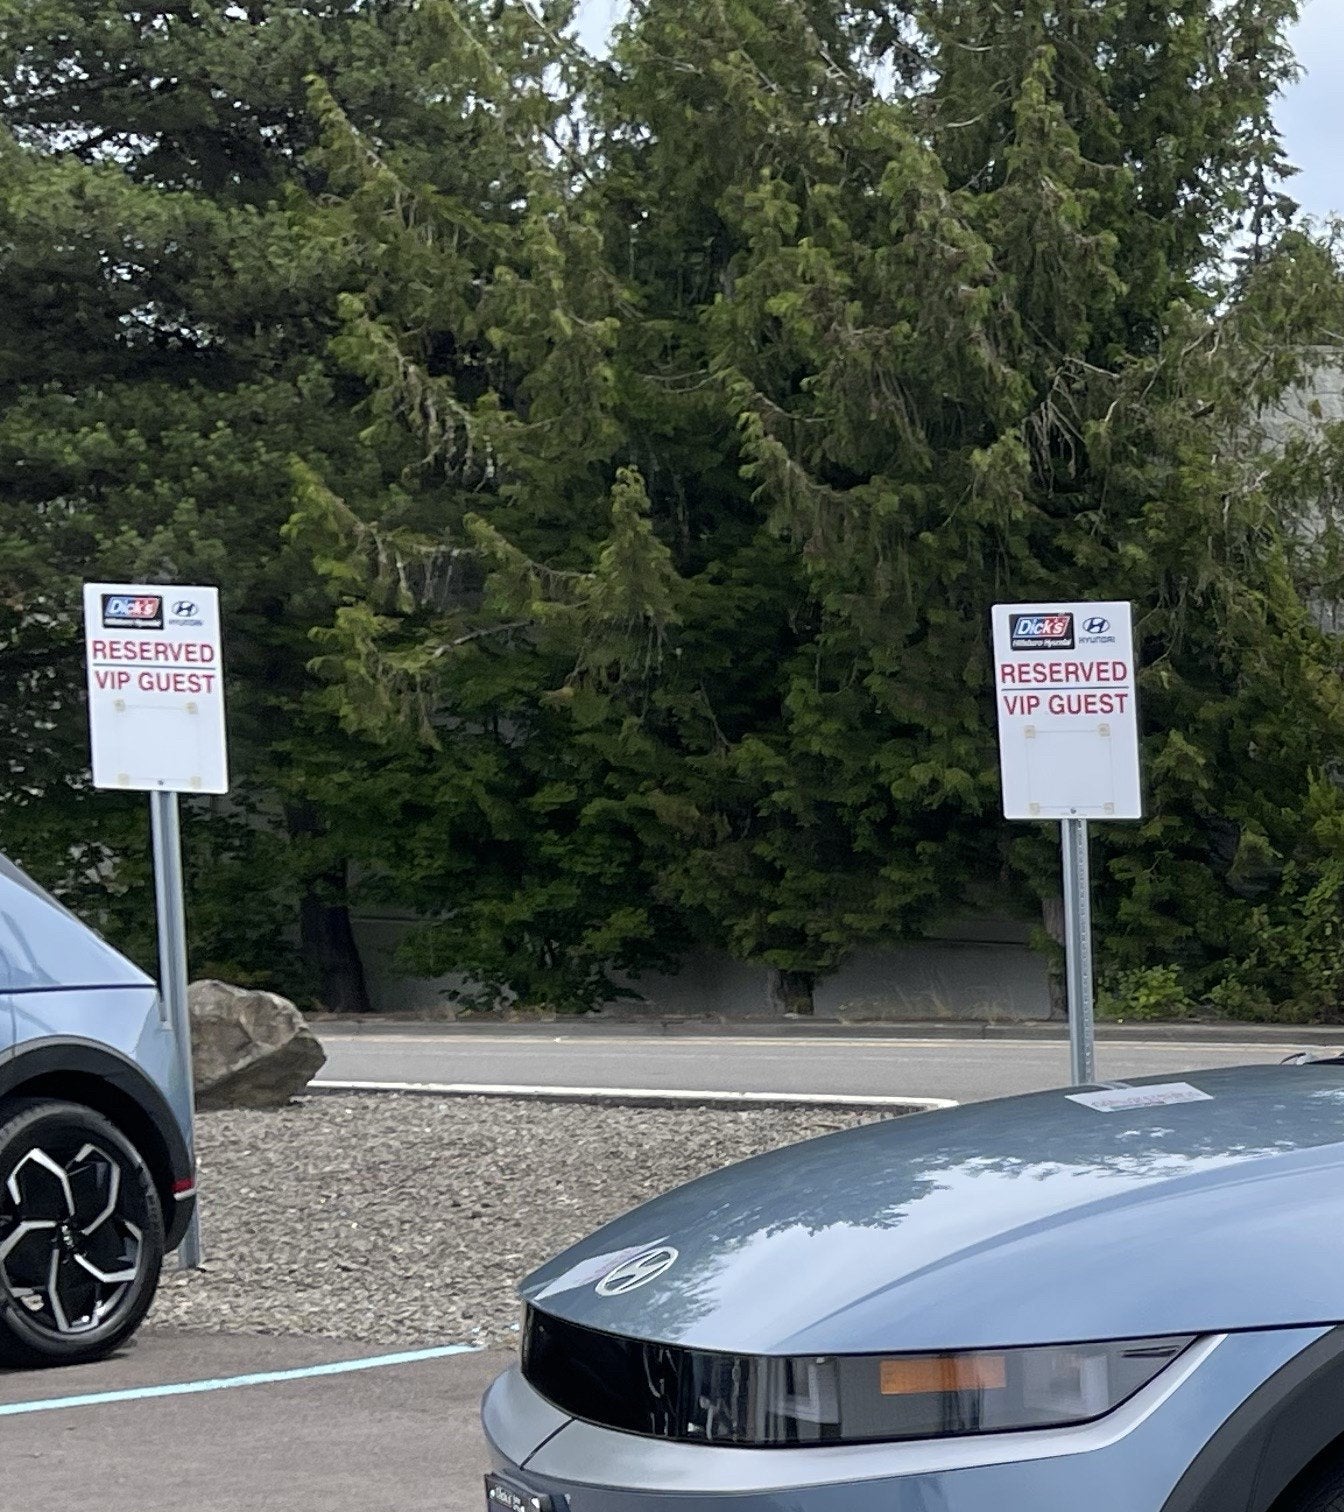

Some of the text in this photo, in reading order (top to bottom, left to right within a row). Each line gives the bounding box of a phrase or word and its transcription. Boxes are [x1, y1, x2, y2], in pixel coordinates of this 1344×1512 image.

[92, 640, 215, 663] RESERVED
[95, 671, 216, 694] VIP GUEST
[1000, 661, 1127, 684] RESERVED
[1003, 693, 1128, 715] VIP GUEST
